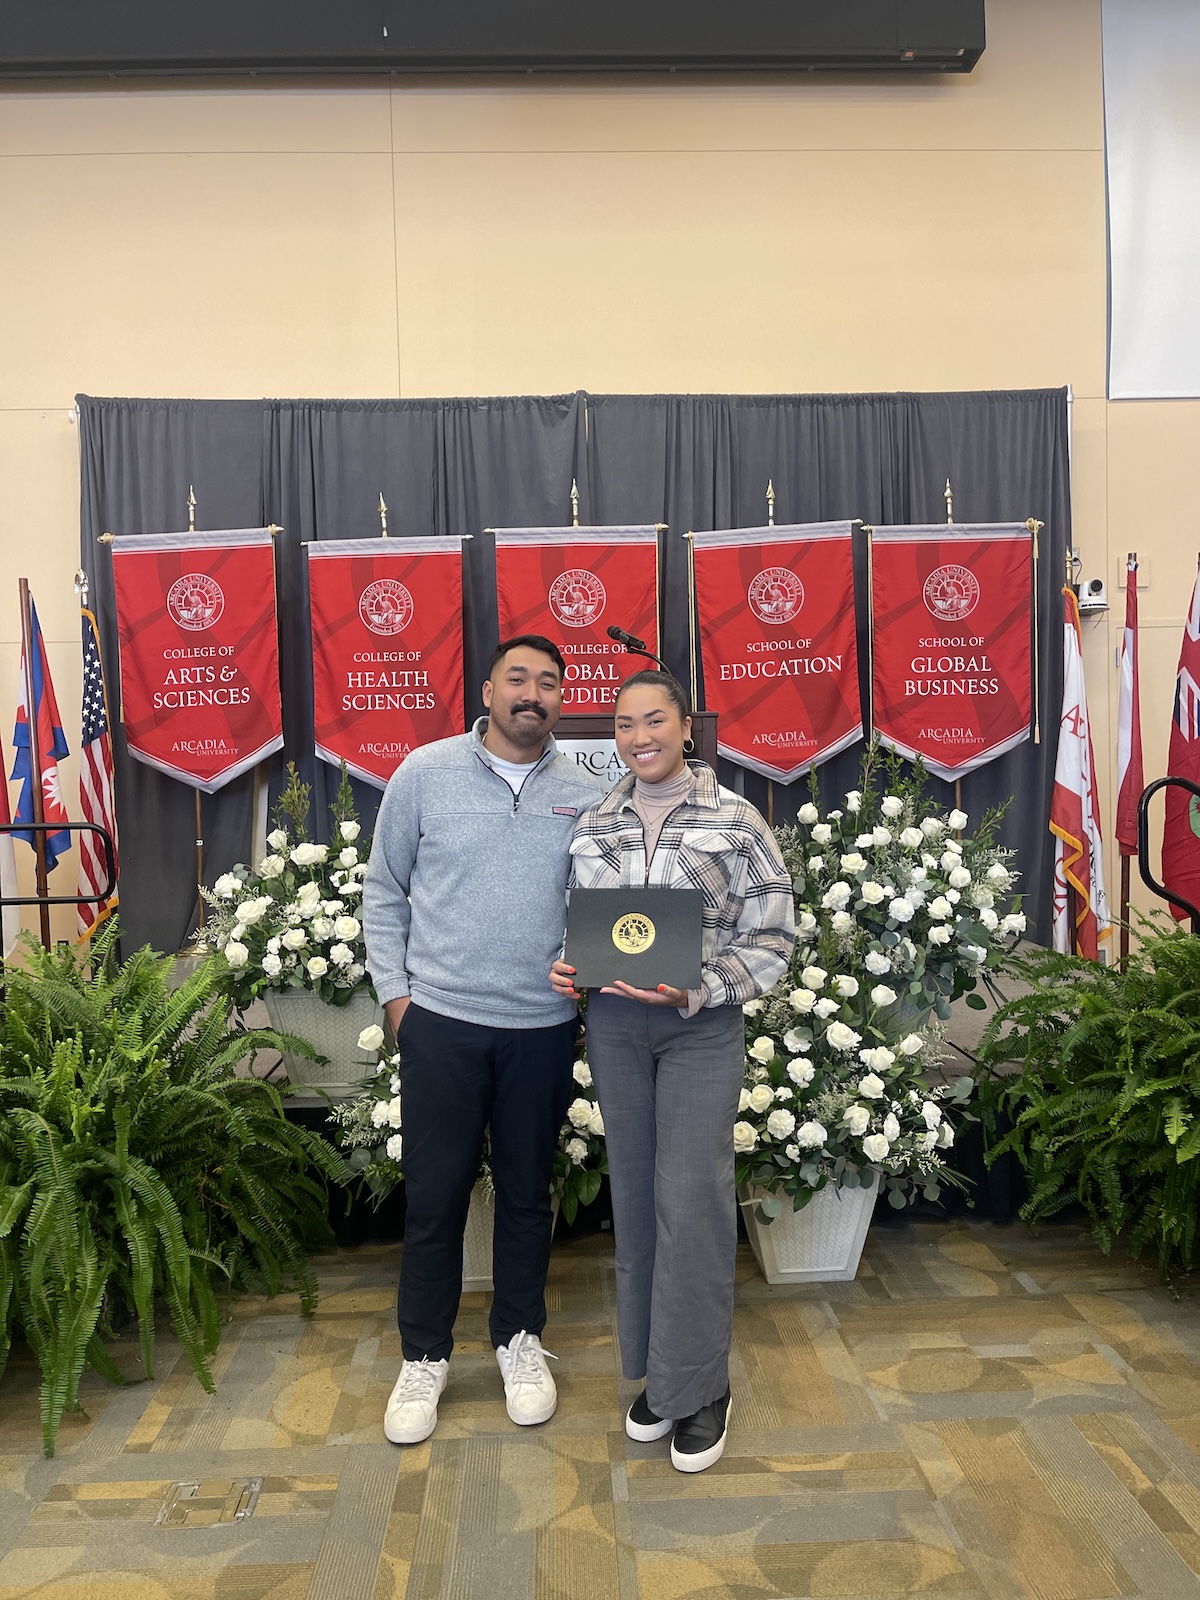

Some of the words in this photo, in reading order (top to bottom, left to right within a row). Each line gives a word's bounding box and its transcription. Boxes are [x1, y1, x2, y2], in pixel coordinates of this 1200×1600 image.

[551, 573, 571, 601] ARCADIA
[572, 571, 604, 600] UNIVERSITY
[750, 572, 769, 600] ARCADIA
[770, 569, 802, 596] UNIVERSITY
[925, 569, 946, 596] ARCADIA
[946, 567, 978, 595] UNIVERSITY
[170, 578, 189, 606] ARCADIA
[190, 575, 222, 602] UNIVERSITY
[361, 583, 380, 610] ARCADIA
[381, 581, 411, 608] UNIVERSITY
[612, 644, 627, 653] OF
[747, 640, 794, 652] SCHOOL
[797, 639, 811, 648] OF
[919, 638, 966, 647] SCHOOL
[969, 637, 984, 646] OF
[164, 647, 216, 659] COLLEGE
[219, 646, 234, 656] OF
[354, 652, 404, 662] COLLEGE
[407, 652, 421, 661] OF
[565, 664, 619, 680] OBAL
[720, 655, 842, 681] EDUCATION
[912, 656, 991, 672] GLOBAL
[164, 667, 215, 684] ARTS
[220, 666, 237, 681] &
[348, 671, 428, 687] HEALTH
[560, 686, 620, 704] UDIES
[905, 679, 998, 695] BUSINESS
[154, 688, 250, 708] SCIENCES
[343, 693, 434, 710] SCIENCES
[752, 731, 806, 746] ARCADIA
[918, 728, 973, 741] ARCADIA
[172, 739, 226, 753] ARCADIA
[358, 742, 410, 756] ARCADIA
[777, 739, 818, 748] UNIVERSITY
[196, 748, 239, 756] UNIVERSITY
